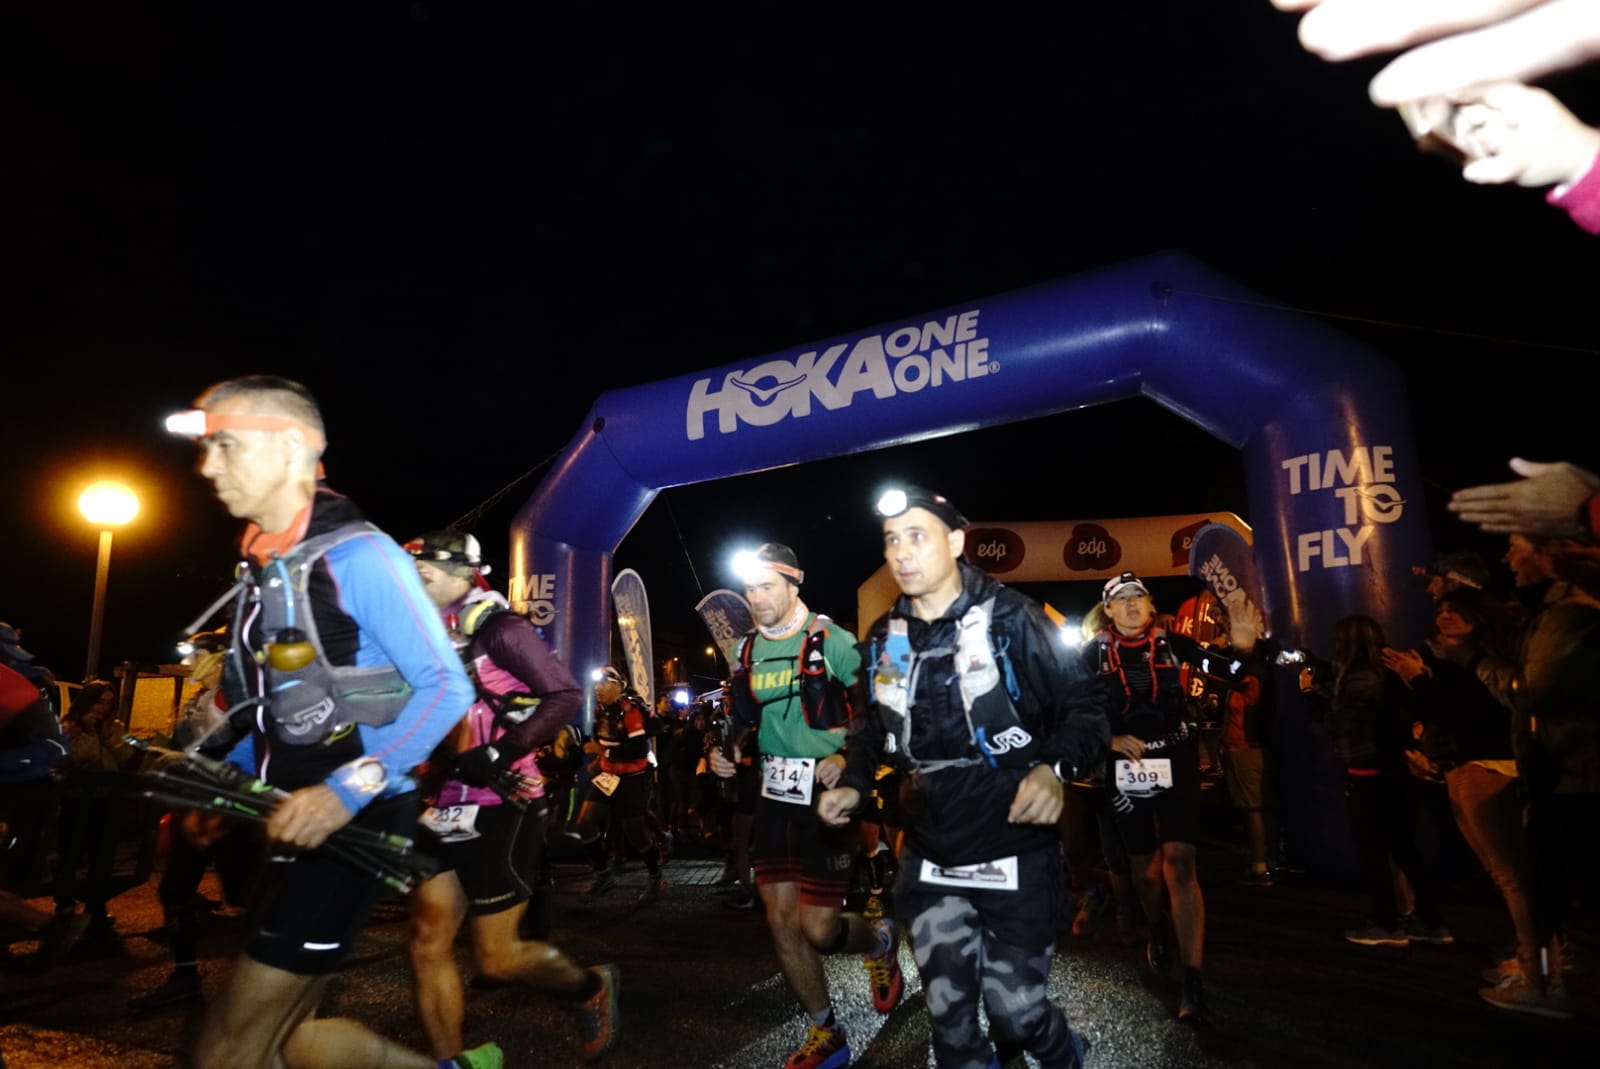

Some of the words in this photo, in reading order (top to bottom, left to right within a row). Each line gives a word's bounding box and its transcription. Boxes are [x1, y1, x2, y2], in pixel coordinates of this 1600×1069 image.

[884, 309, 980, 358] ONE
[686, 334, 897, 441] HOKA
[1281, 446, 1396, 495] TIME
[1334, 484, 1404, 525] TO
[976, 539, 1007, 561] edp
[1077, 536, 1107, 559] edp
[1297, 525, 1375, 572] FLY
[770, 766, 800, 783] 214
[1127, 771, 1159, 784] 309
